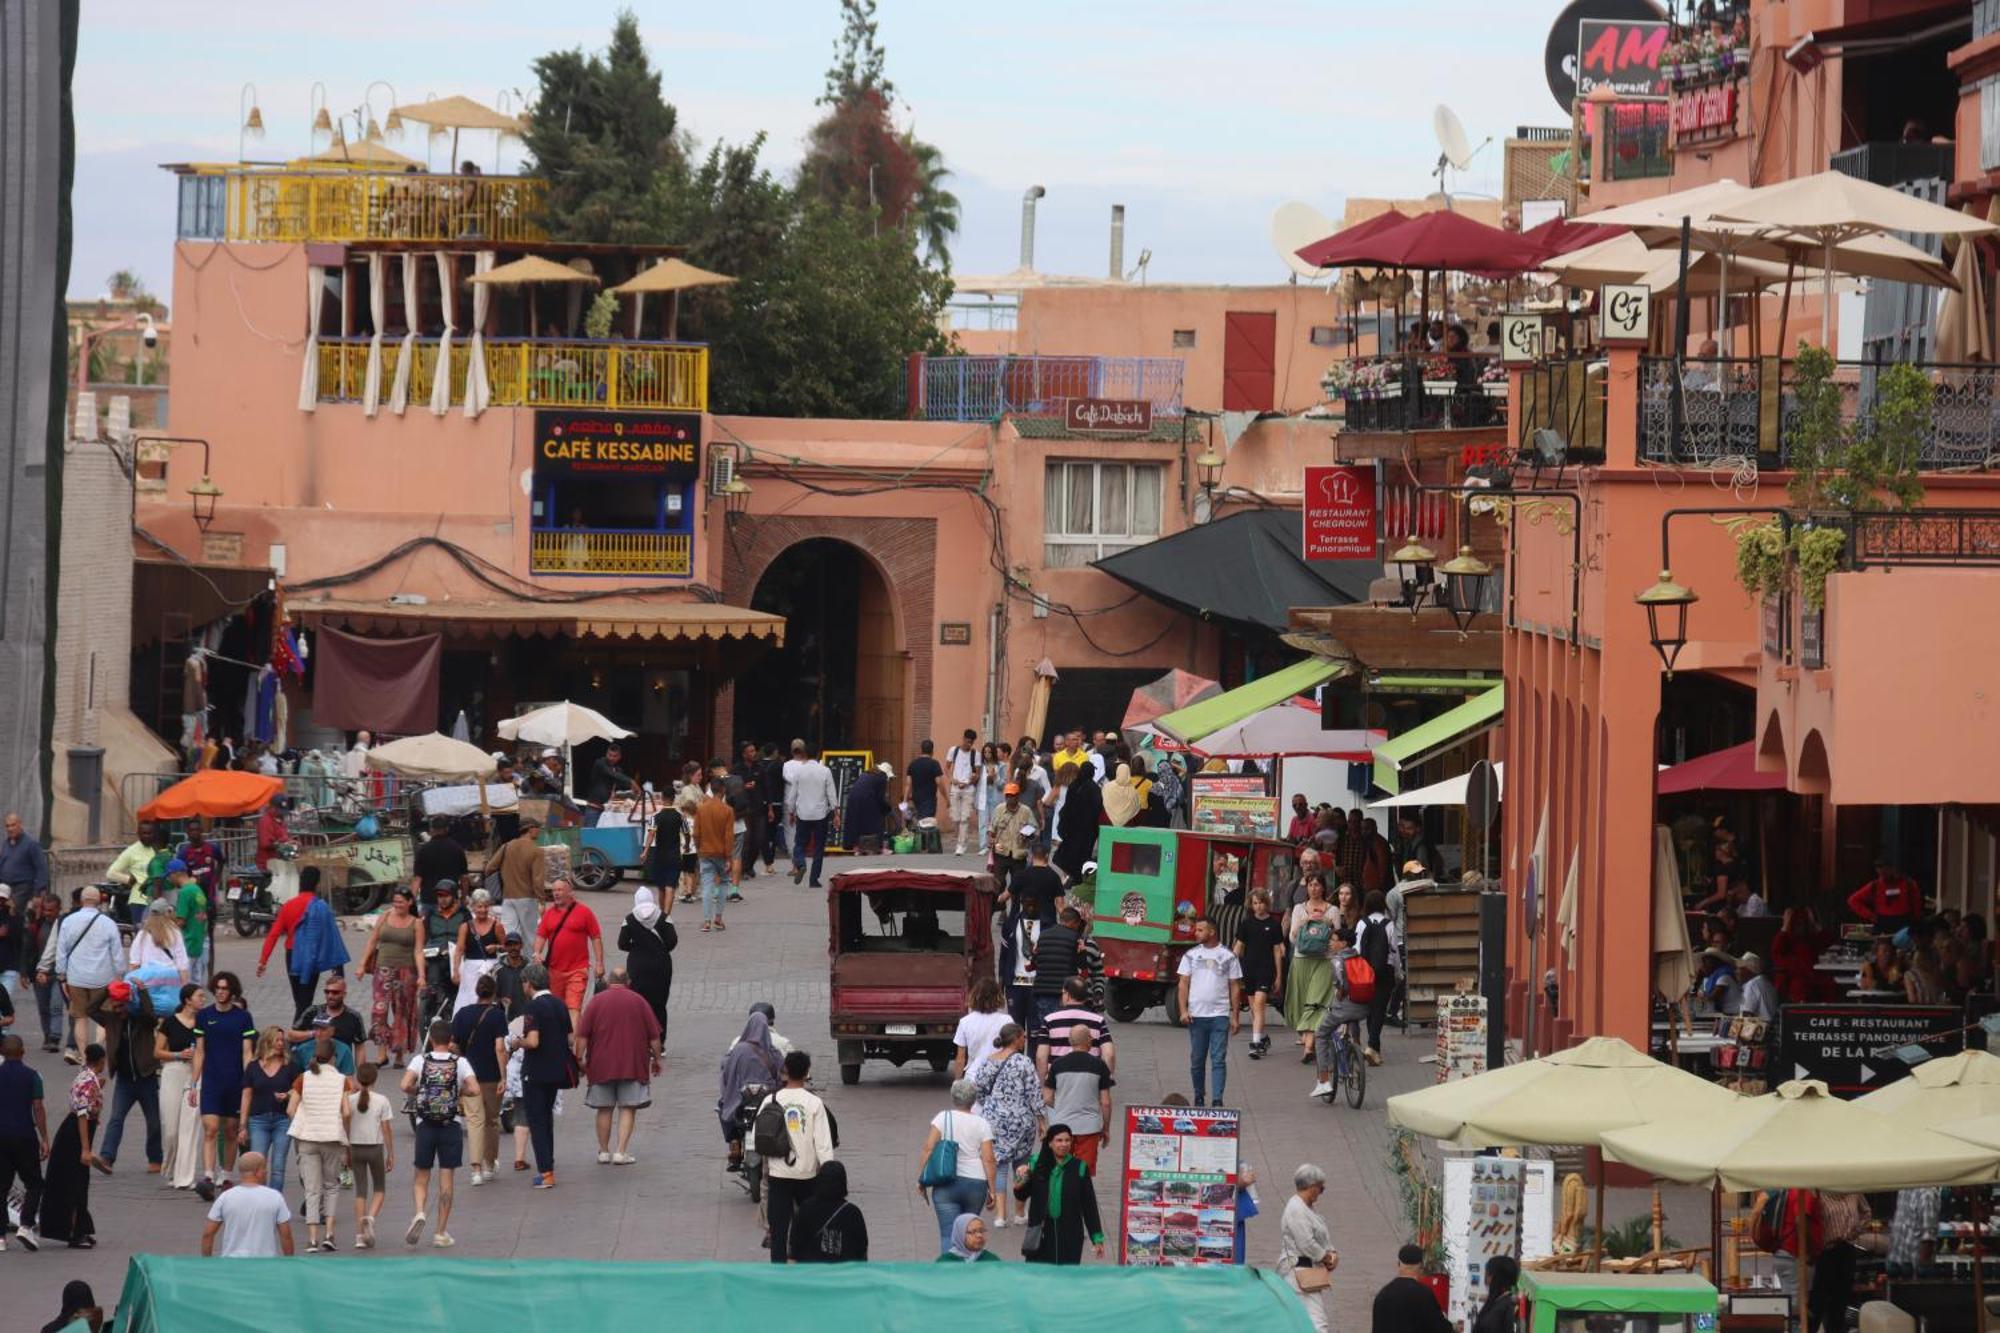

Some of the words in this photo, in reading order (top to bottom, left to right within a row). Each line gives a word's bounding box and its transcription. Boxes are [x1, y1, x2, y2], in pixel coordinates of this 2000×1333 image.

[1581, 77, 1651, 94] Retaurant
[543, 436, 592, 460] CAFÉ
[596, 441, 695, 462] KESSABINE
[1309, 509, 1370, 518] RESTAURANT
[1320, 535, 1360, 543] Terrasse
[1310, 545, 1371, 554] Panoramique
[1810, 1018, 1841, 1027] CAFE
[1851, 1019, 1930, 1028] RESTAURANT
[1793, 1032, 1855, 1041] TERRASSE
[1859, 1034, 1946, 1043] PANORAMIQUE
[1822, 1048, 1841, 1058] DE
[1846, 1048, 1864, 1058] LA
